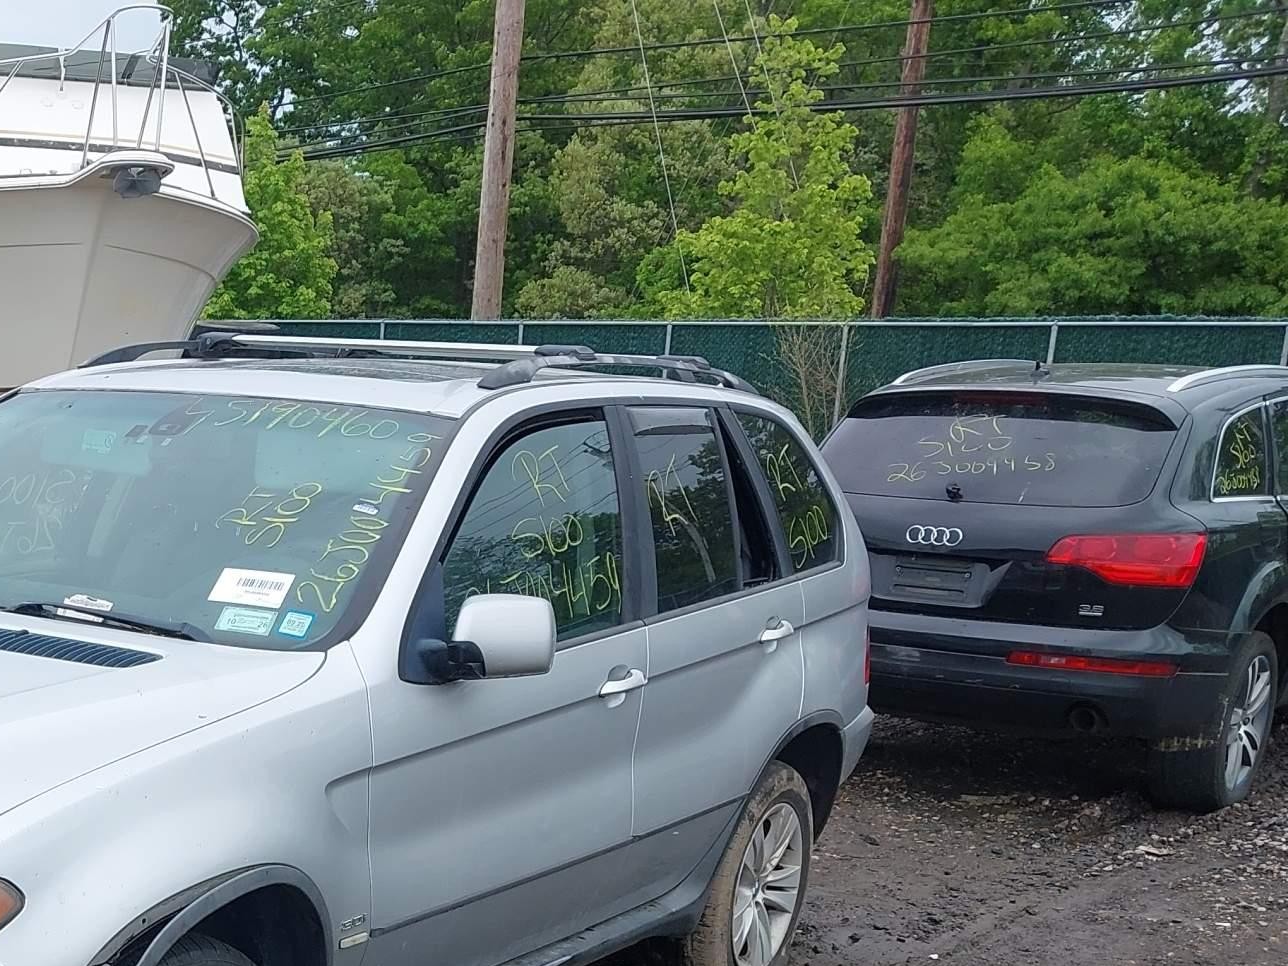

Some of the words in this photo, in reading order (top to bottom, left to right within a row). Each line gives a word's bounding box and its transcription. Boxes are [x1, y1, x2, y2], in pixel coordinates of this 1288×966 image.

[184, 397, 400, 439] 45190460
[949, 413, 1009, 443] RT
[512, 444, 570, 507] RT
[647, 453, 699, 537] RT
[766, 443, 803, 502] RT
[215, 486, 275, 529] RT
[512, 514, 583, 559] S100
[788, 505, 828, 569] S100
